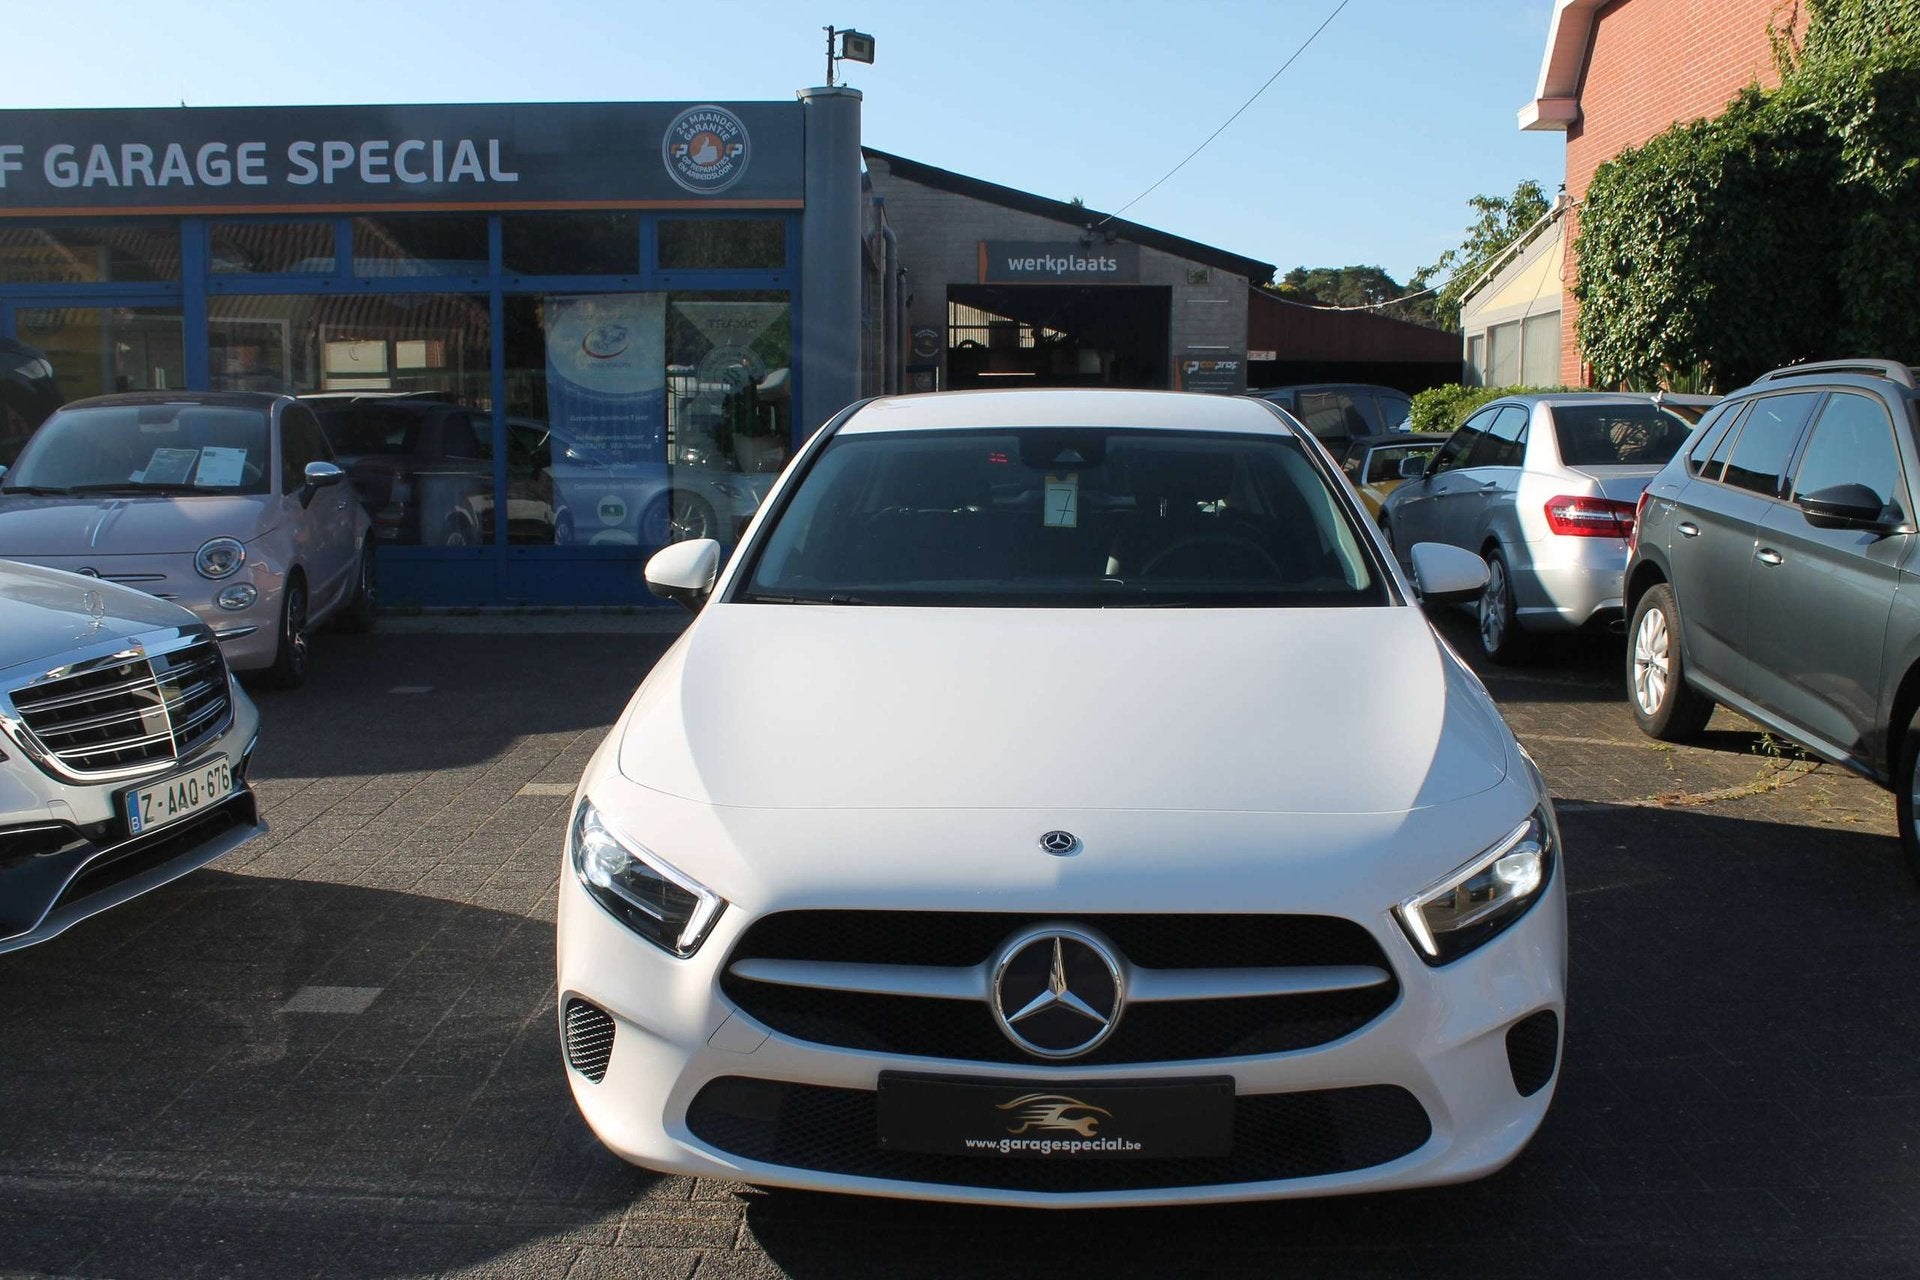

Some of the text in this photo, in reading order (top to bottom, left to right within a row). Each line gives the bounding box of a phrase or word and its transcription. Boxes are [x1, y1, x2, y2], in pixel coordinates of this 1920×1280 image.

[675, 113, 739, 136] 24 MAANDEN
[684, 123, 731, 142] GARANTIE
[43, 142, 267, 188] GARAGE
[287, 139, 519, 184] SPECIAL
[686, 162, 734, 180] ARBEIDSLOON
[690, 156, 730, 173] REPARATIES
[1008, 254, 1117, 275] werkplaats
[1049, 488, 1074, 525] 7
[141, 763, 230, 825] Z-AAQ-676
[131, 816, 140, 830] B
[965, 1137, 1142, 1154] www.garagespecial.be
